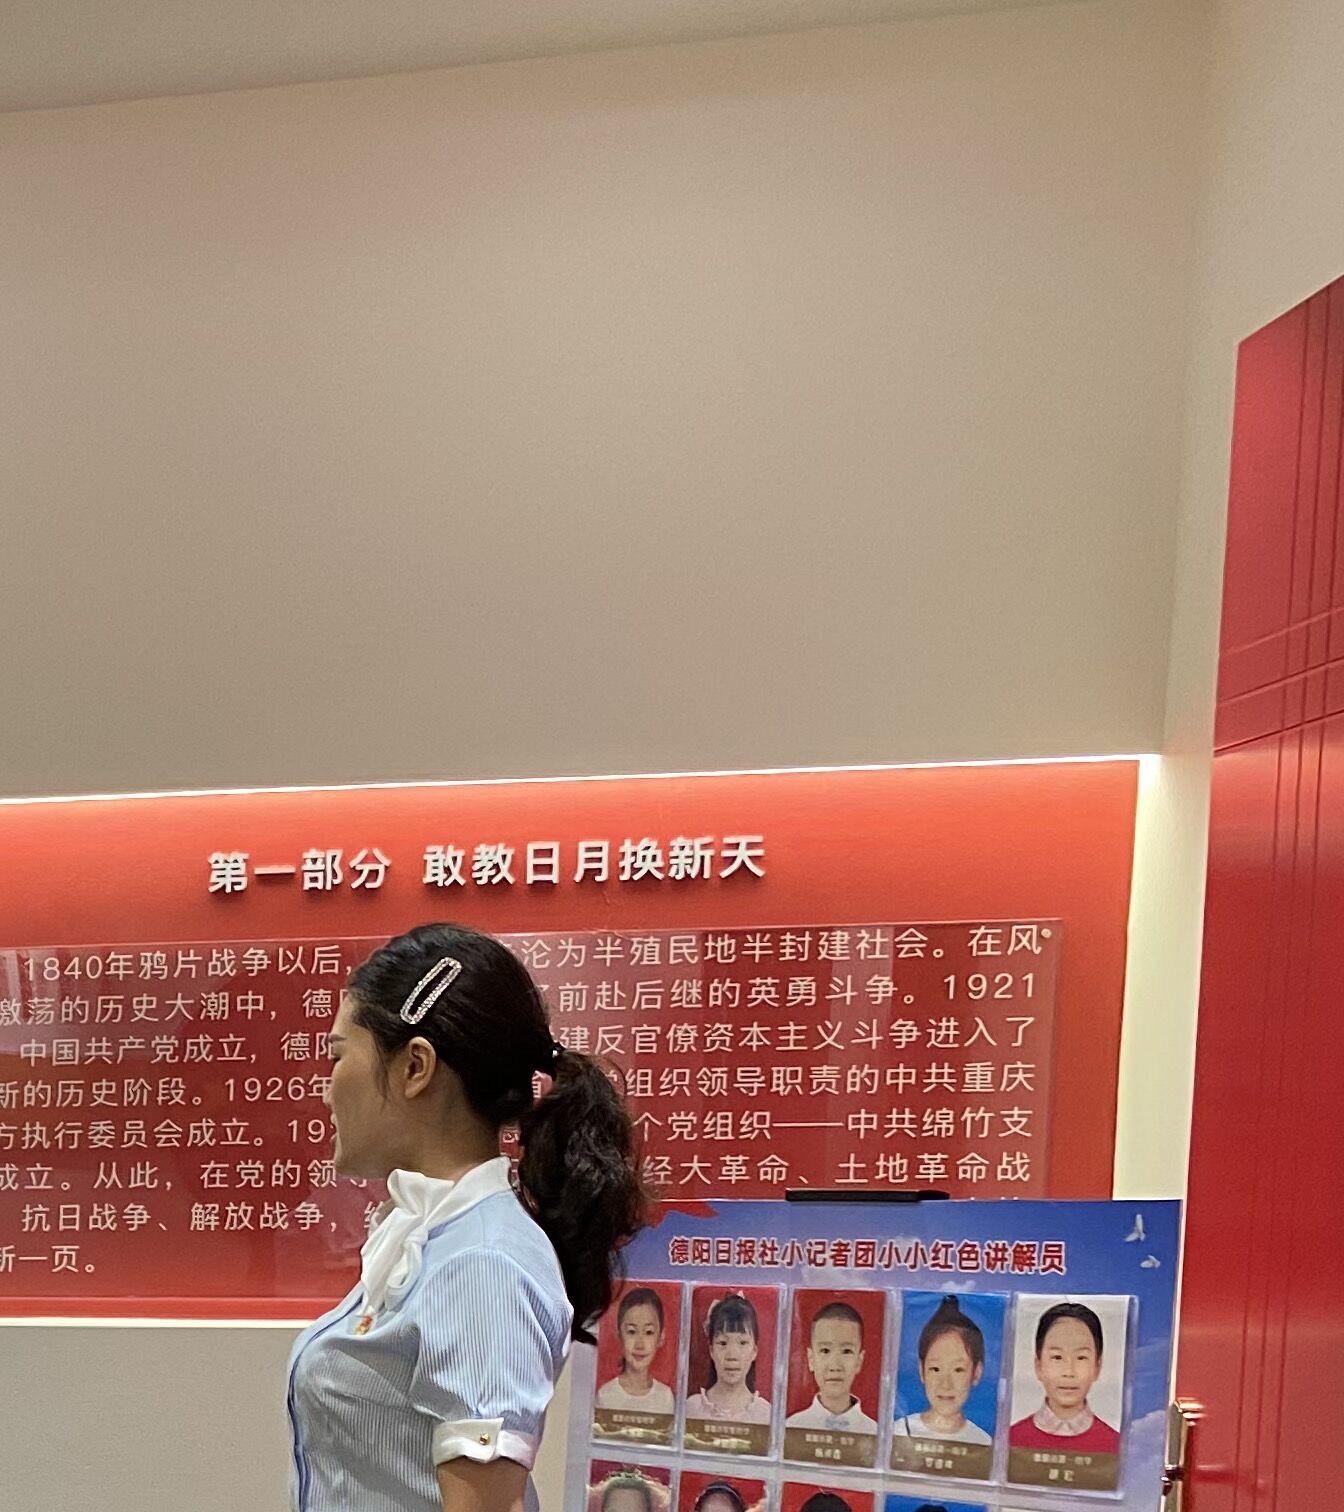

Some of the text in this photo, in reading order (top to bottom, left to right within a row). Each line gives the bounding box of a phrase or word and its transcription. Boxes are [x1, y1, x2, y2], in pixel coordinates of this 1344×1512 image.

[208, 835, 766, 893] 第一部分 敢教日月换新天
[23, 924, 1042, 982] 1840年鸦片战争以后， 沦为半殖民地半封建社会。在风
[534, 973, 1036, 1013] 前赴后继的英勇斗争。1921
[549, 1016, 1036, 1056] 建反官僚资本主义斗争进入了
[605, 1061, 1036, 1099] 组织领导职责的中共重庆
[668, 1235, 1067, 1276] 德阳日报社小记者团小小红色讲解员
